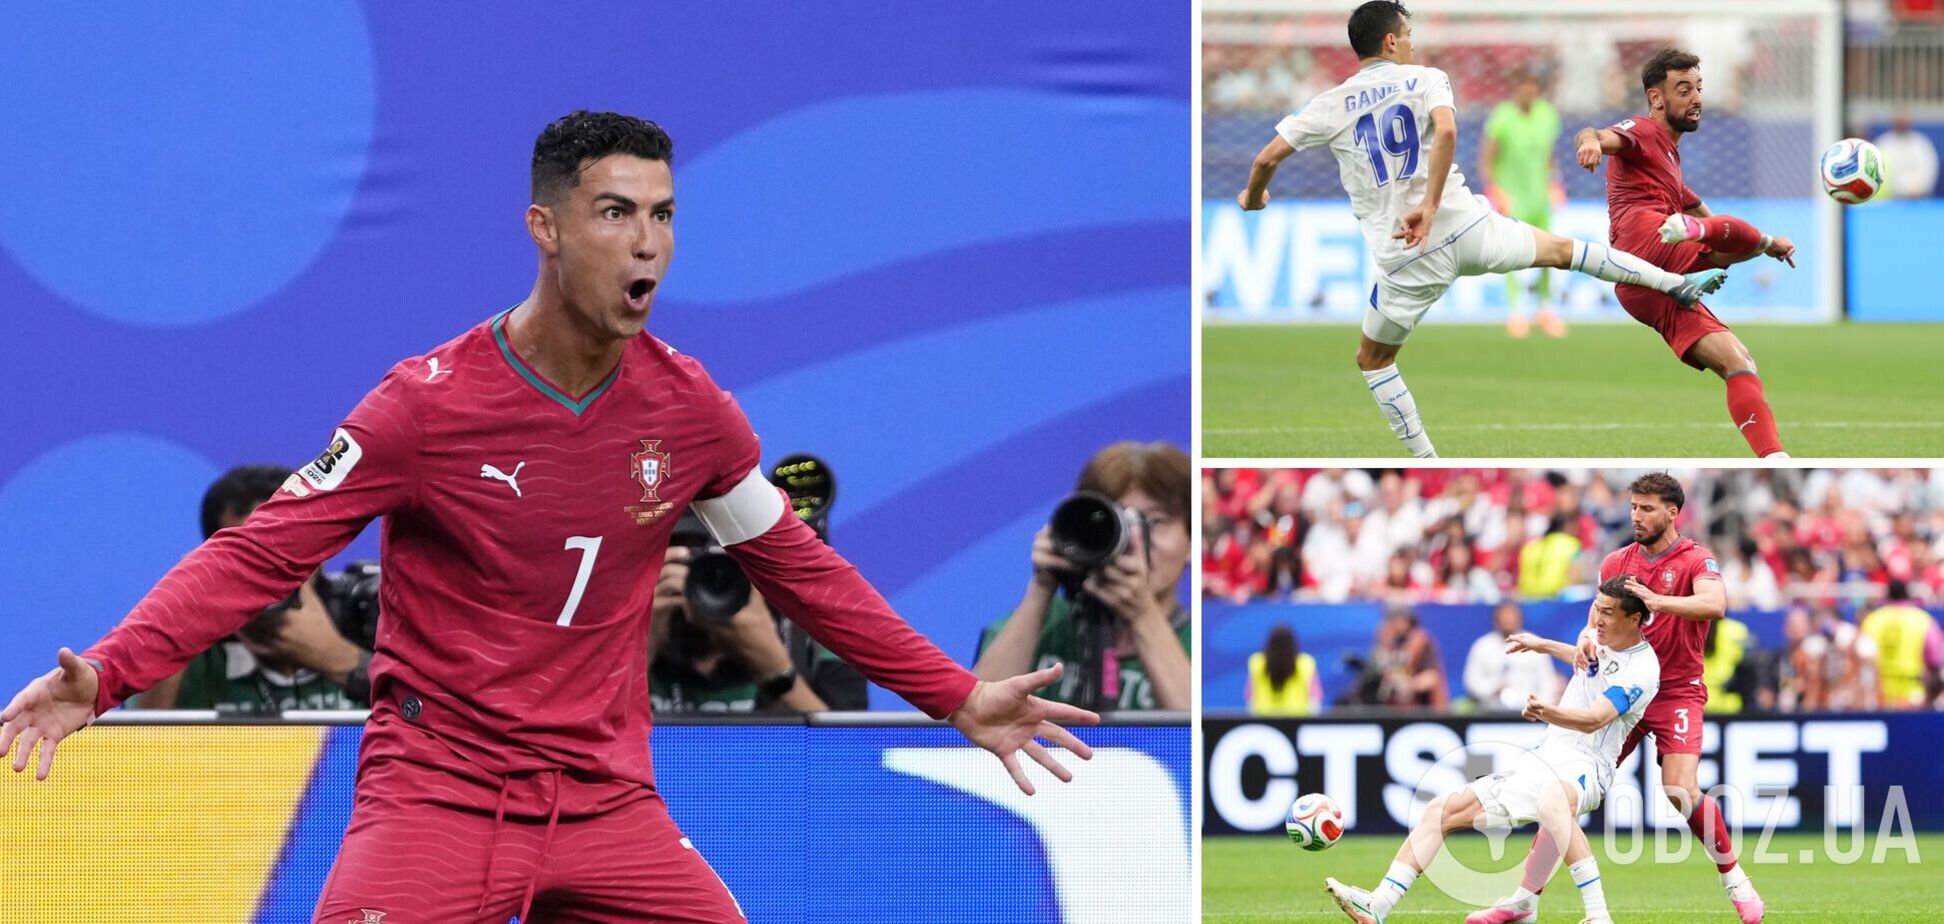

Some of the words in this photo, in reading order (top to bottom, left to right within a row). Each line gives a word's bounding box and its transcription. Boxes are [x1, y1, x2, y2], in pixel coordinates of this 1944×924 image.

[1353, 101, 1420, 188] 19
[556, 535, 603, 627] 7
[1673, 707, 1689, 734] 3
